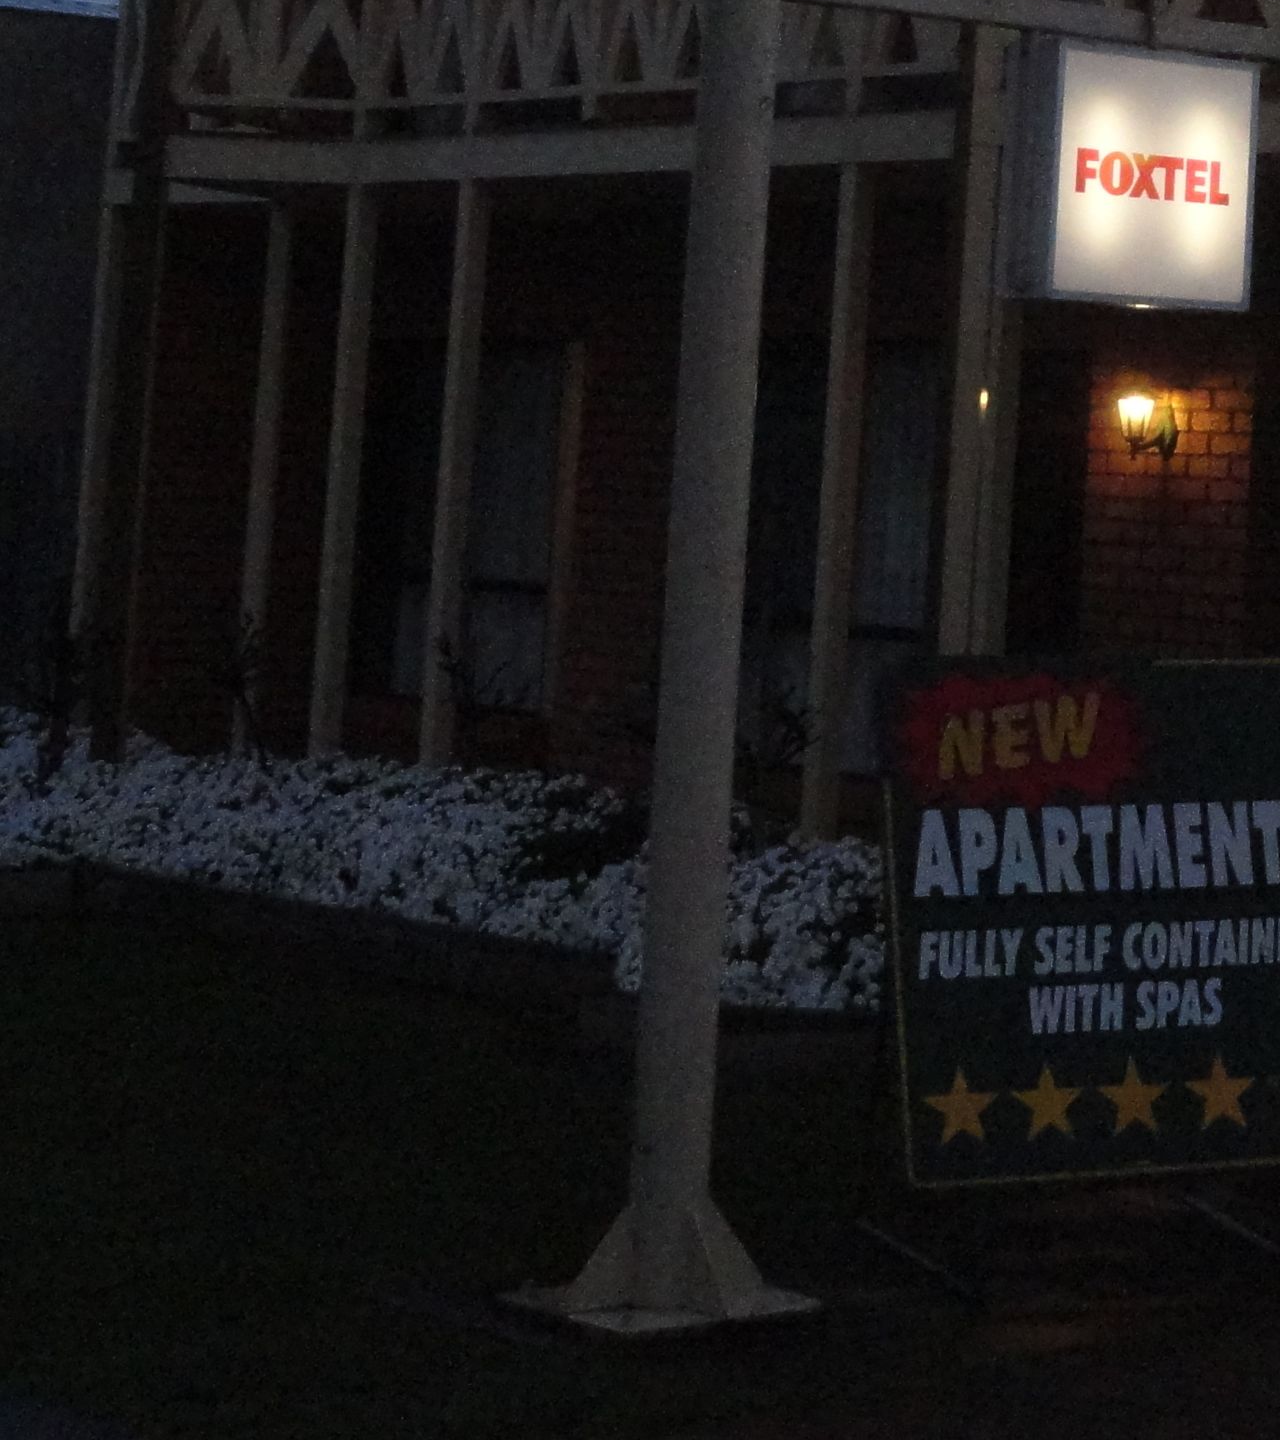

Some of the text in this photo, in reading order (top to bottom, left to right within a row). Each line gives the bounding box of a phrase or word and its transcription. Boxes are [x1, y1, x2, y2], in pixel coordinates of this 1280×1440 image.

[1074, 147, 1230, 206] FOXTEL
[937, 690, 1100, 780] NEW
[917, 927, 1024, 981] FULLY
[1034, 924, 1113, 976] SELF
[1028, 976, 1225, 1036] WITH SPAS
